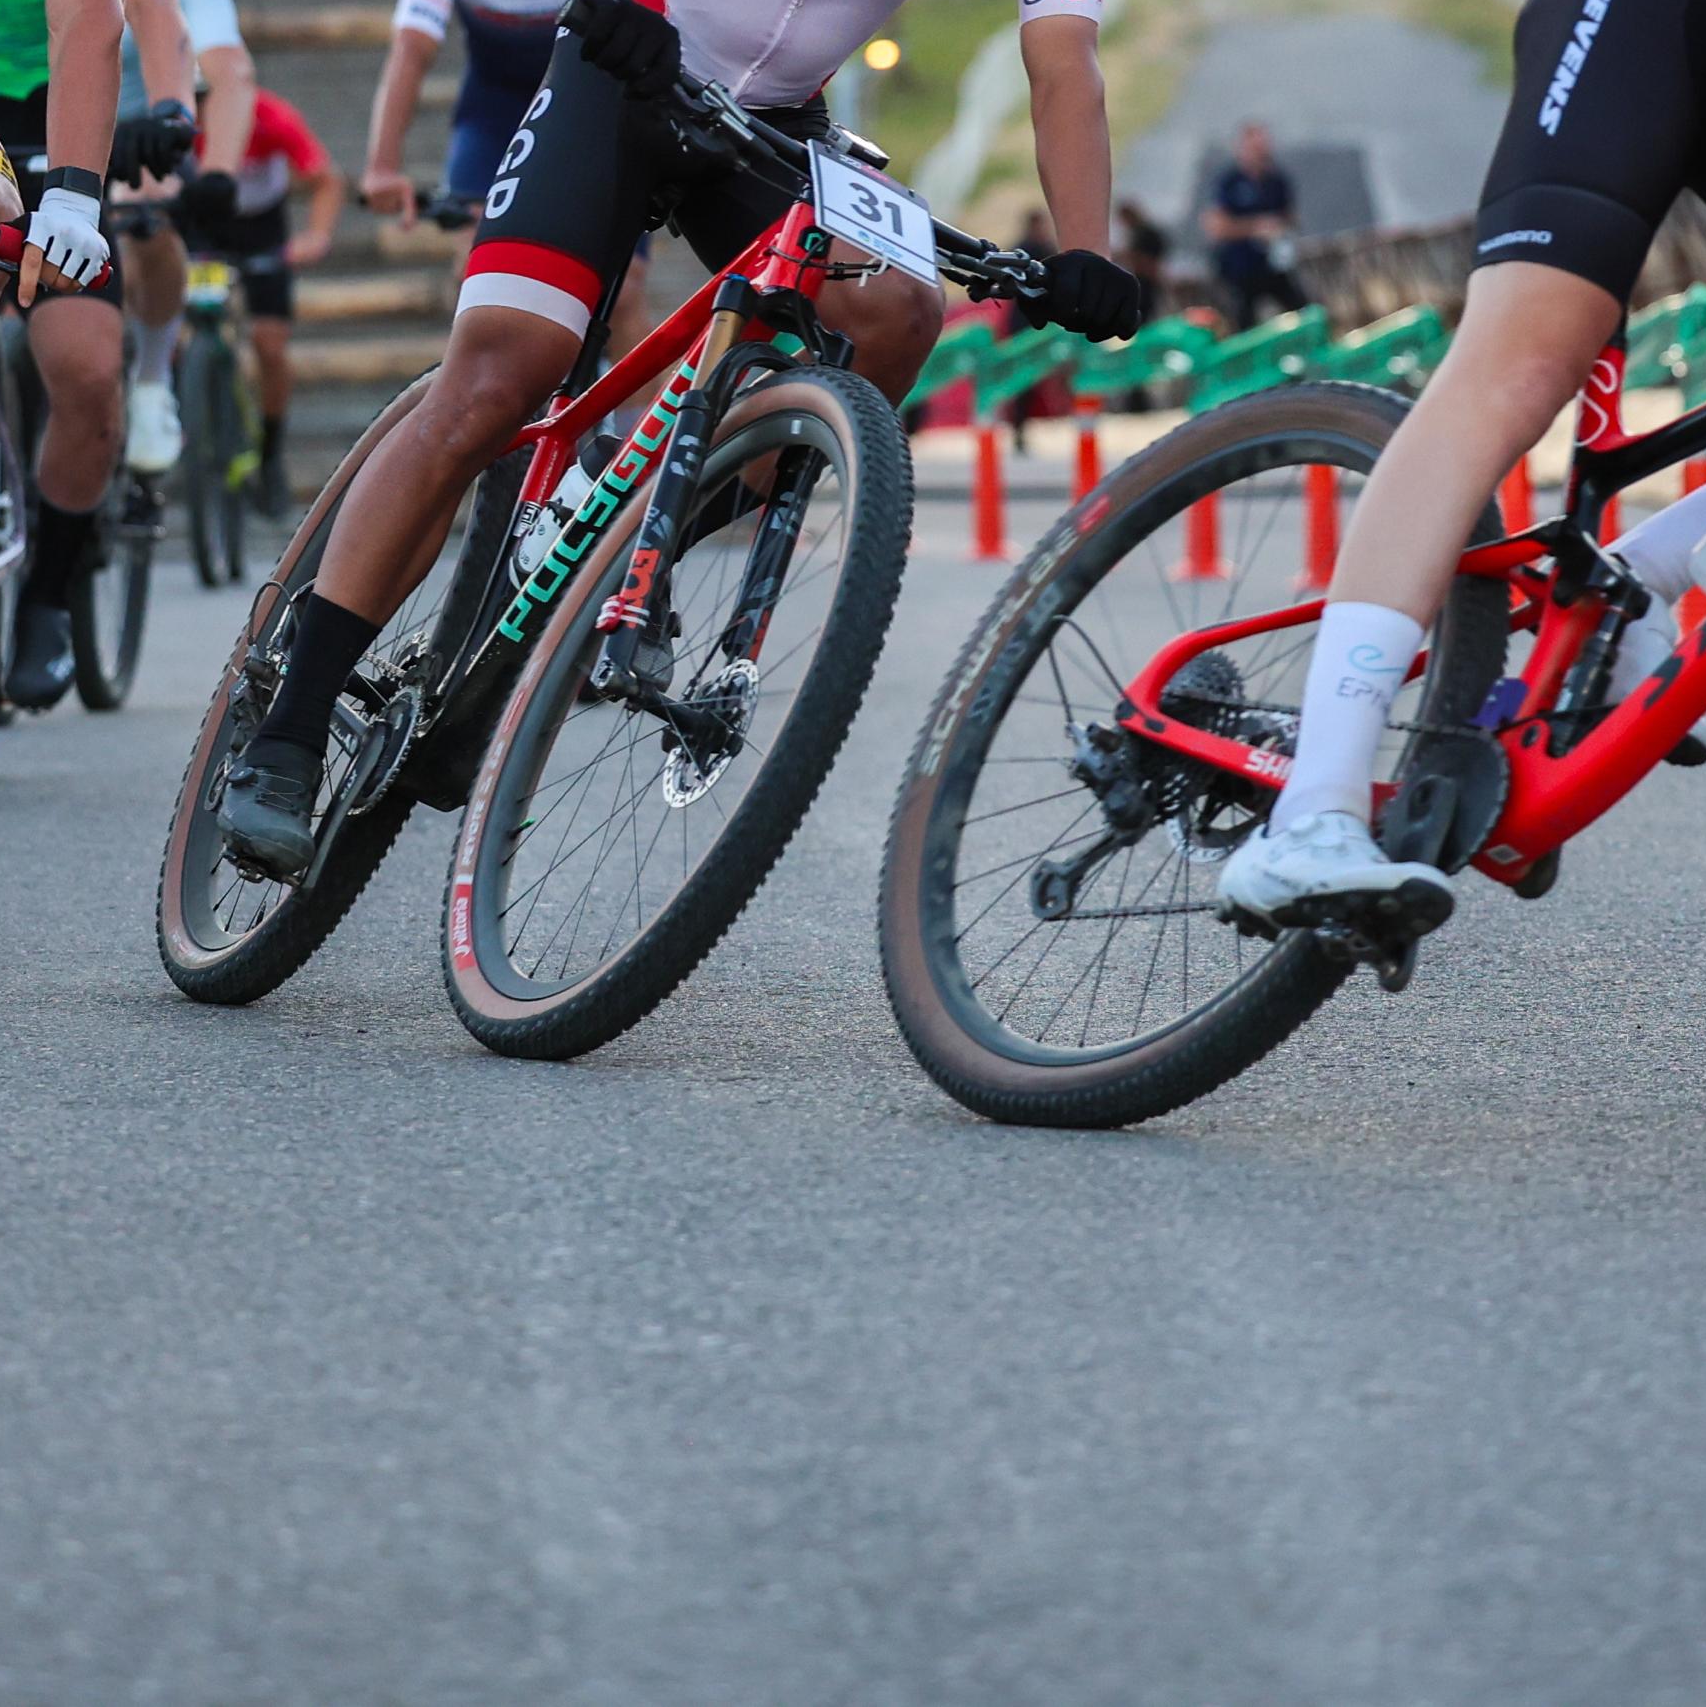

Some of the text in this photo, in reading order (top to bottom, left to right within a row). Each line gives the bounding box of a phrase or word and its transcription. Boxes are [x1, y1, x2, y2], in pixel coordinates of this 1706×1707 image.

[849, 182, 903, 237] 31
[920, 526, 1079, 776] SCHWALBE
[454, 896, 470, 947] vittoria
